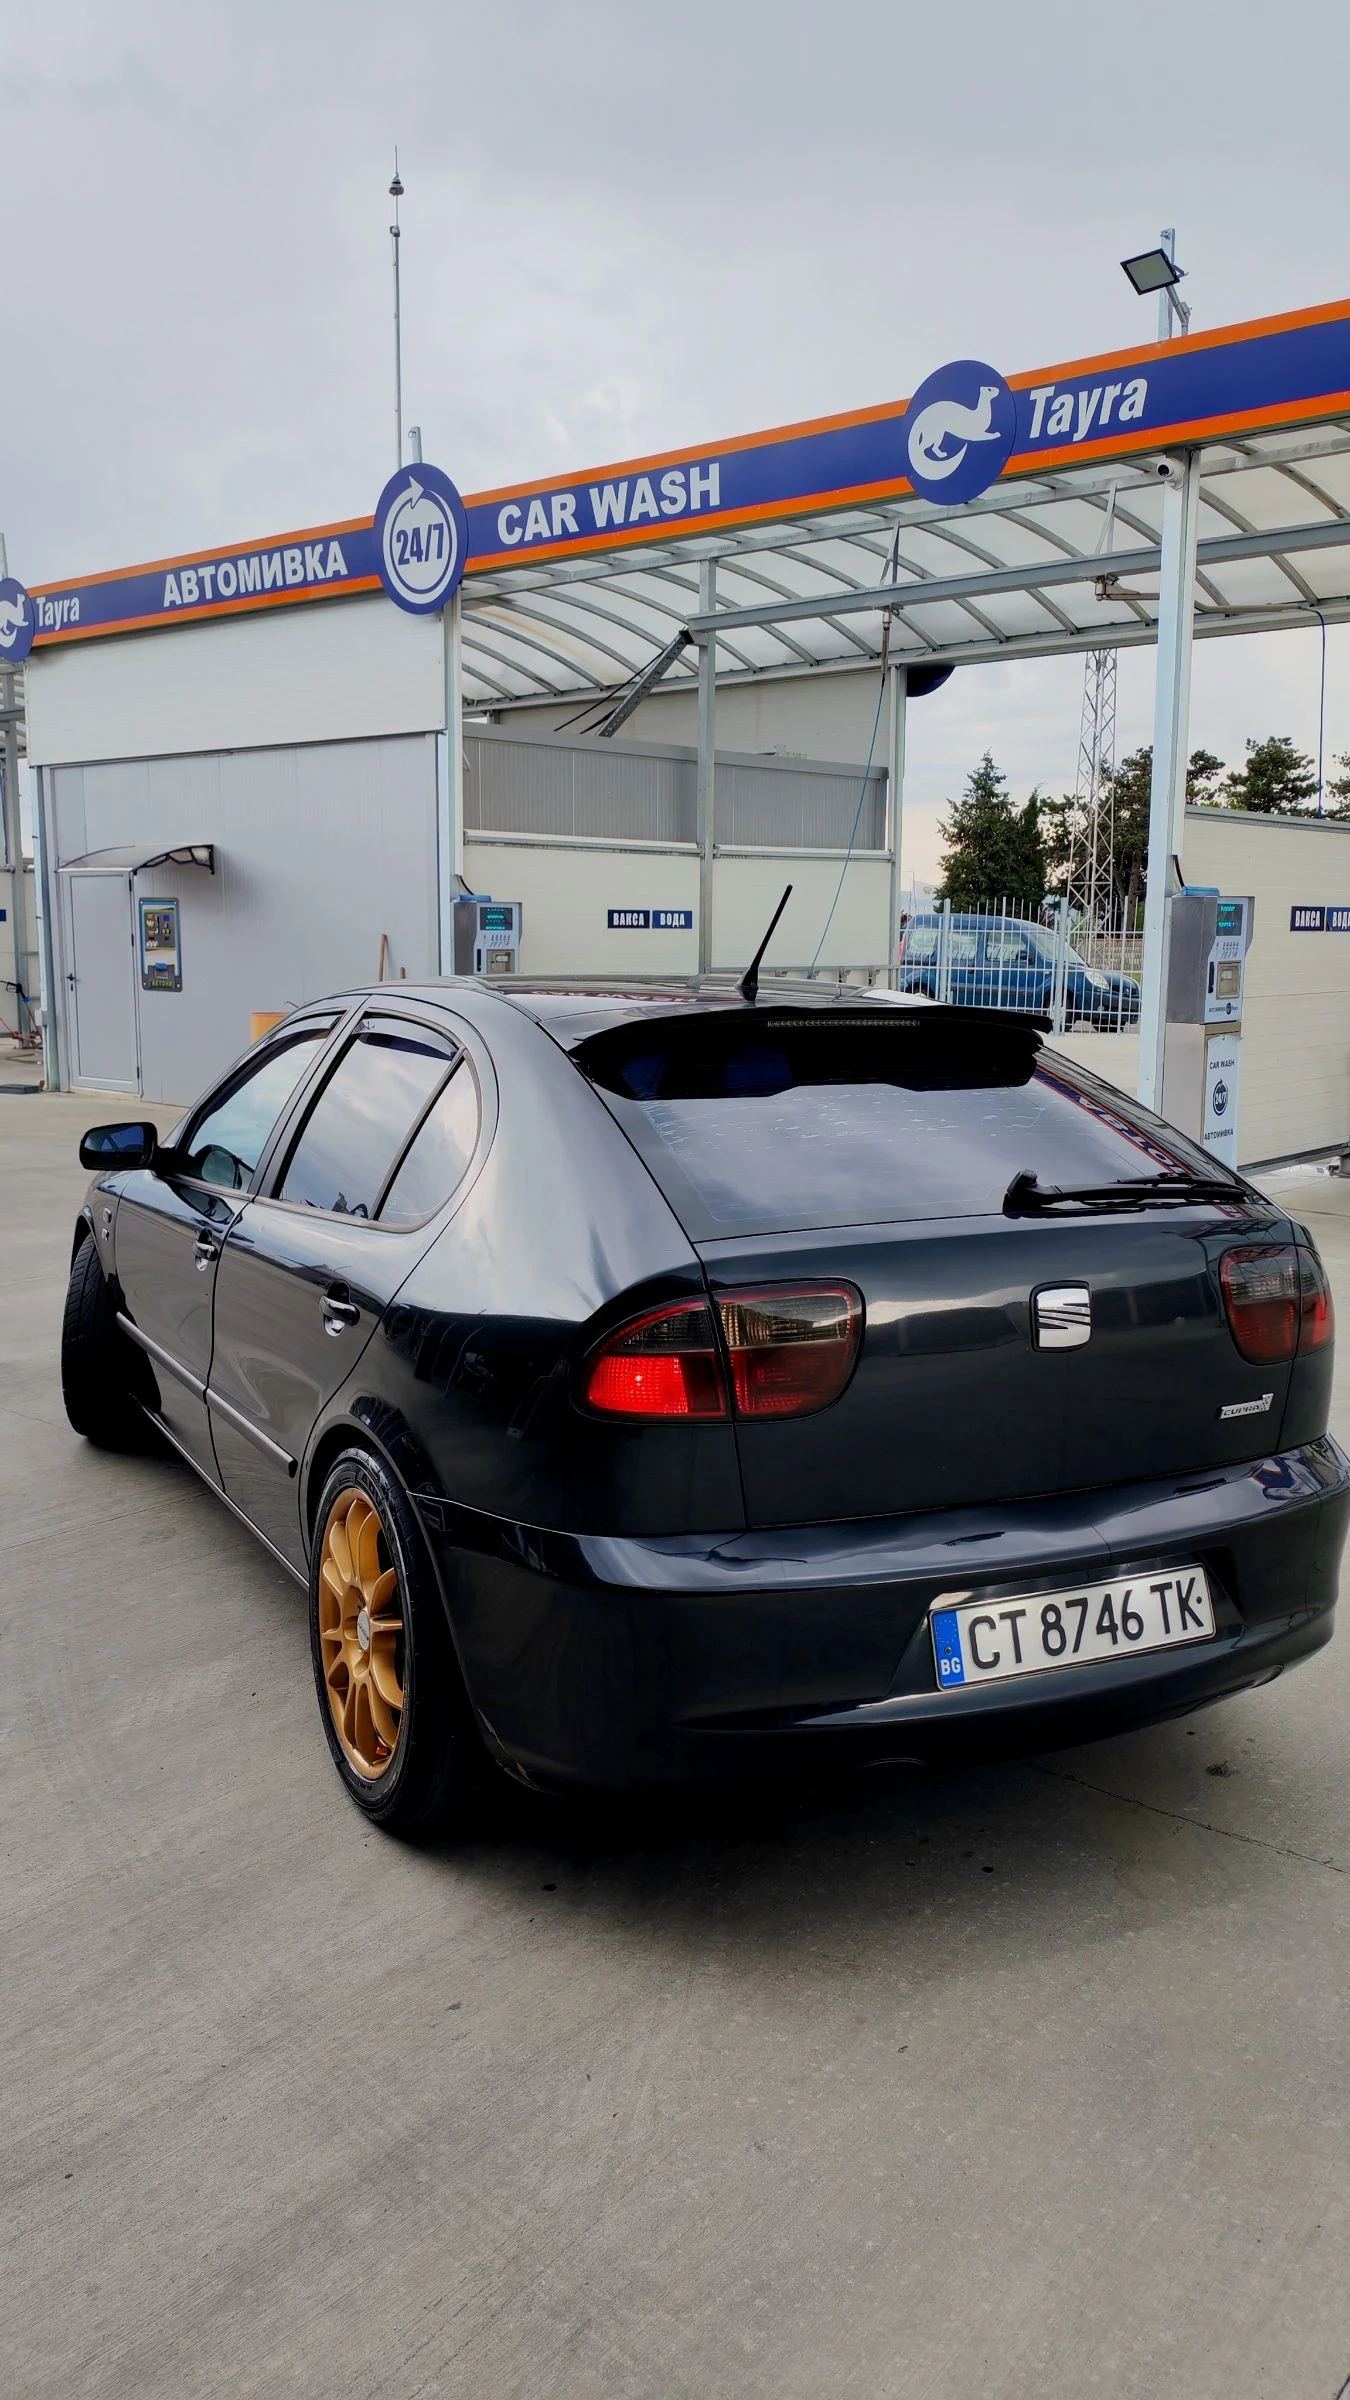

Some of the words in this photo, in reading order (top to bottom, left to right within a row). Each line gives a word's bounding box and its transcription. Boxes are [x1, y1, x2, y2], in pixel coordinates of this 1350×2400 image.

[1029, 378, 1148, 440] Tayra
[497, 491, 577, 547] CAR
[590, 462, 722, 528] WASH
[396, 522, 445, 566] 24/7
[163, 541, 348, 607] АВТОМИВКА
[36, 595, 80, 632] Tayra
[613, 912, 645, 926] ВАКСА
[660, 912, 685, 928] ВОДА
[1295, 910, 1320, 927] ВАКСА
[1209, 1061, 1220, 1069] CAR
[1220, 1059, 1235, 1068] WASH
[1223, 1405, 1260, 1416] CUPRA
[966, 1609, 1027, 1670] CT
[1040, 1588, 1144, 1657] 8746
[1149, 1576, 1204, 1636] TK
[940, 1656, 962, 1677] BG
